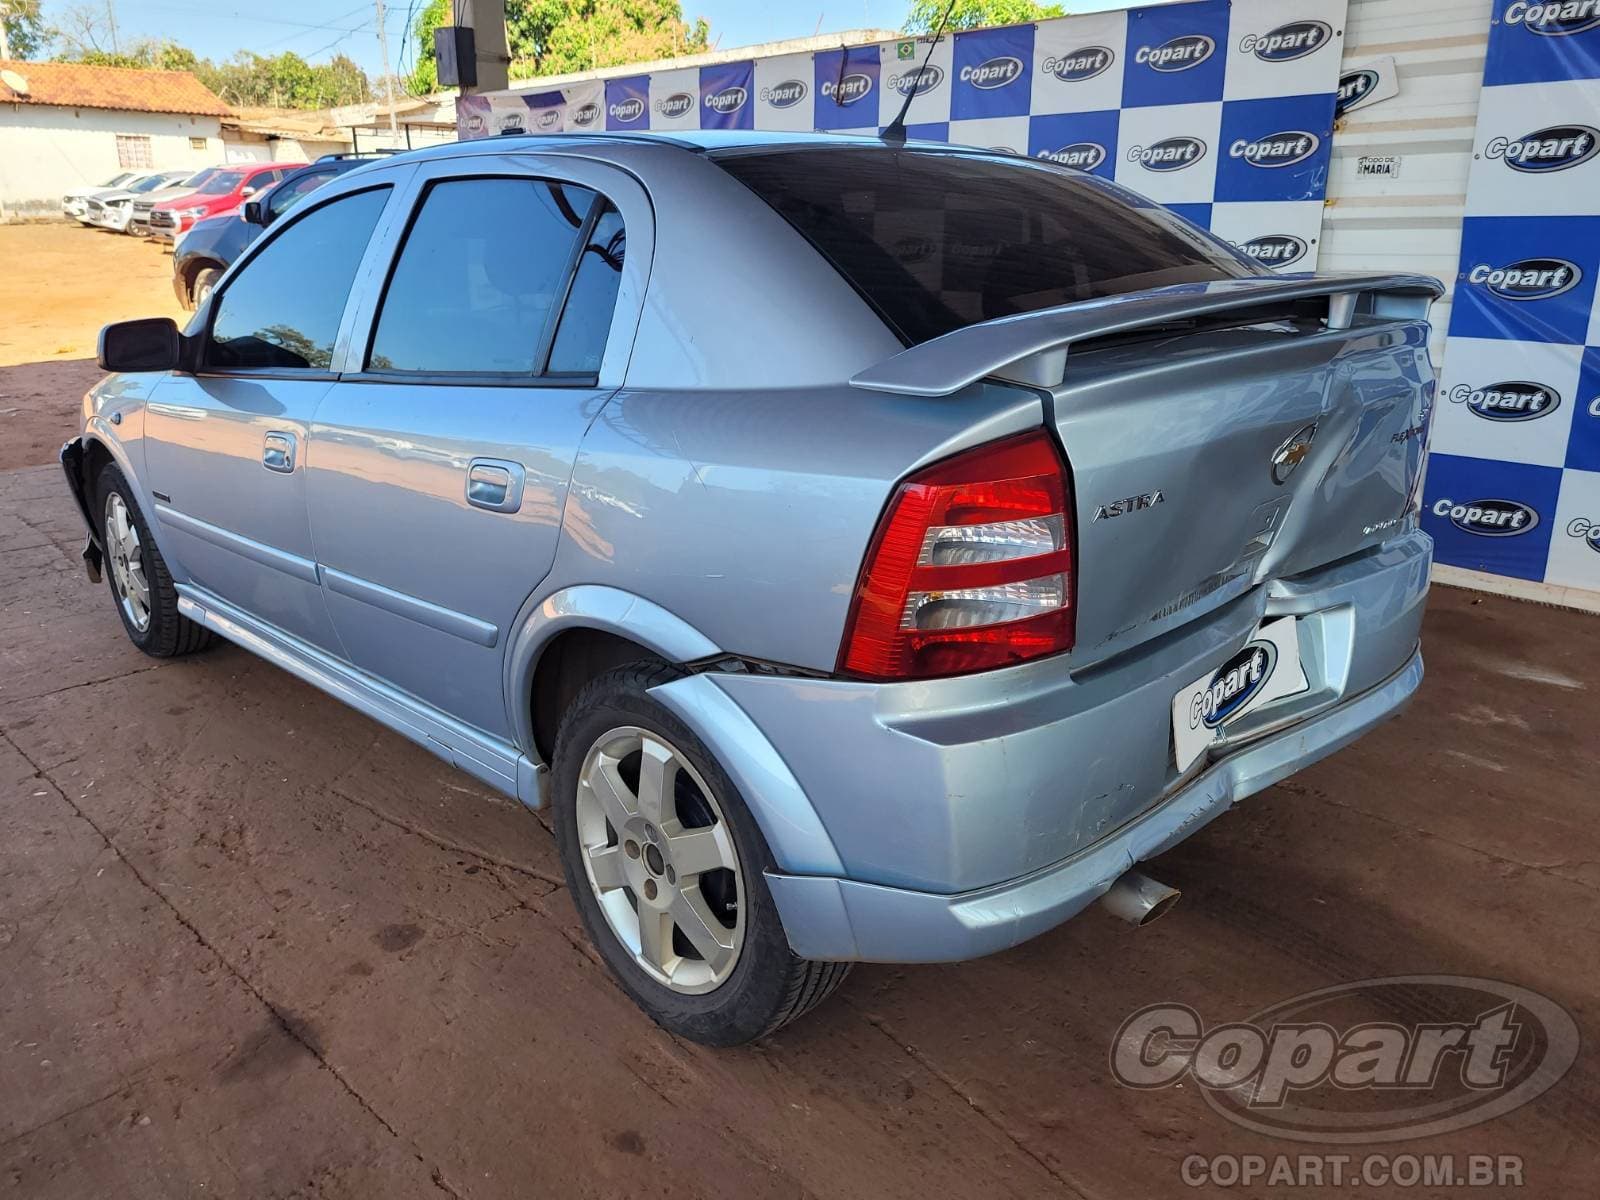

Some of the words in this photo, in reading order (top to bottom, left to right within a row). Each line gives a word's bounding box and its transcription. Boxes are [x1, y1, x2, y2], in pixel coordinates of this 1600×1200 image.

[1135, 38, 1205, 66] Copart
[1239, 25, 1319, 55] Copart
[960, 61, 1016, 86] Copart
[1042, 54, 1105, 77] Copart
[821, 80, 865, 102] Copart
[887, 70, 935, 94] Copart
[655, 100, 690, 117] Copart
[704, 94, 743, 112] Copart
[760, 87, 801, 106] Copart
[609, 103, 640, 119] Copart
[1127, 143, 1197, 167] Copart
[1229, 138, 1308, 163] Copart
[1485, 129, 1590, 164] Copart
[1363, 164, 1391, 175] MARIA
[1227, 240, 1297, 260] opart
[1469, 264, 1569, 288] Copart
[1449, 384, 1545, 411] Copart
[1092, 490, 1165, 523] ASTRA
[1433, 499, 1524, 529] Copart
[1190, 647, 1264, 730] Copart
